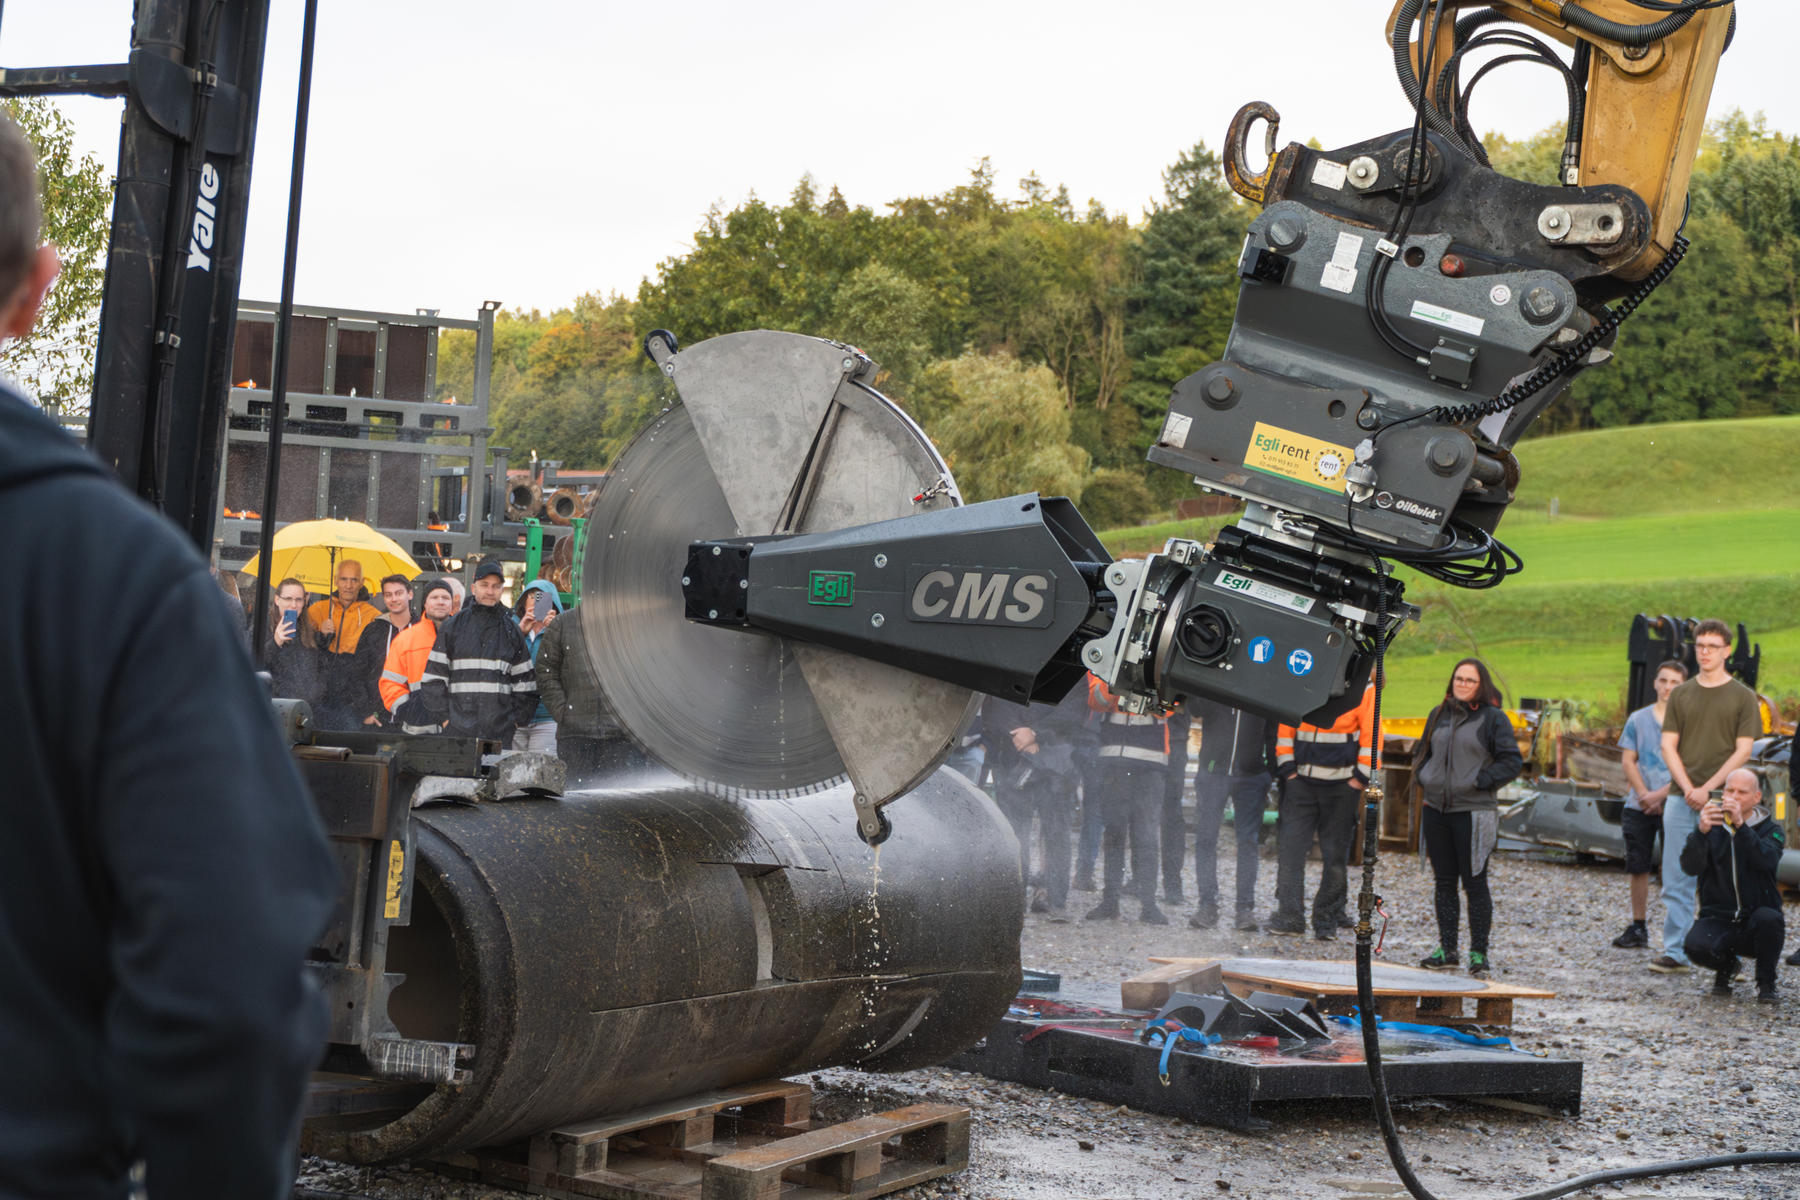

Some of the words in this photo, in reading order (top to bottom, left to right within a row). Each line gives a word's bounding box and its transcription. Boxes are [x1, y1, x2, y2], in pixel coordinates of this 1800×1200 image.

[186, 162, 219, 272] Yale
[1255, 433, 1280, 451] Egli
[1281, 444, 1310, 461] rent
[1320, 460, 1338, 471] rent
[1396, 500, 1438, 519] OilQuick
[813, 575, 848, 601] Egli
[1222, 573, 1254, 591] Egli
[911, 570, 1048, 622] CMS
